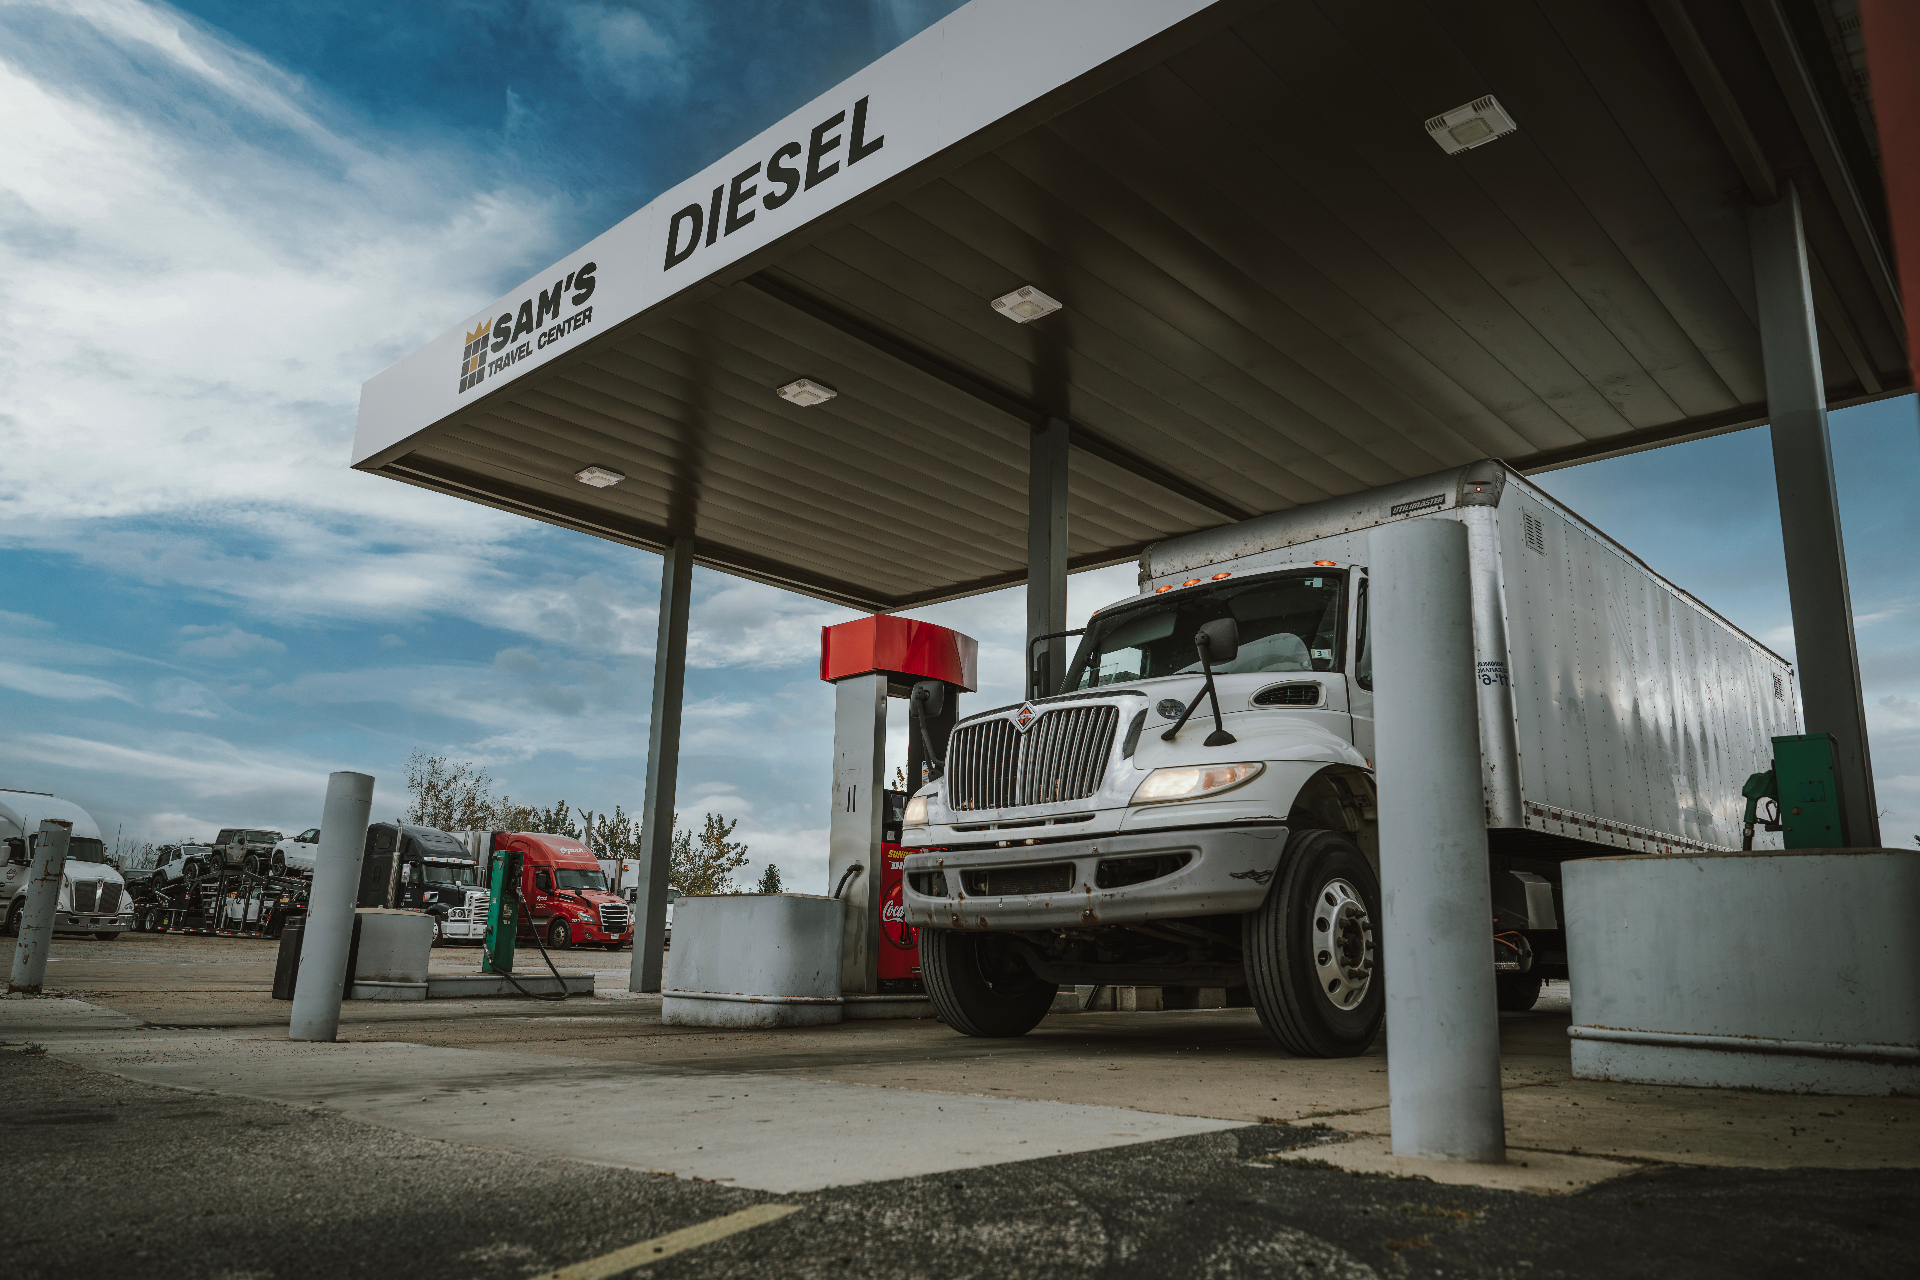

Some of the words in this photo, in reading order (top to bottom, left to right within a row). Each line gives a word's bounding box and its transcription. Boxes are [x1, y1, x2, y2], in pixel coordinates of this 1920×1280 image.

[663, 94, 885, 273] DIESEL
[487, 340, 534, 378] TRAVEL
[537, 305, 594, 351] CENTER
[490, 261, 598, 354] SAM'S
